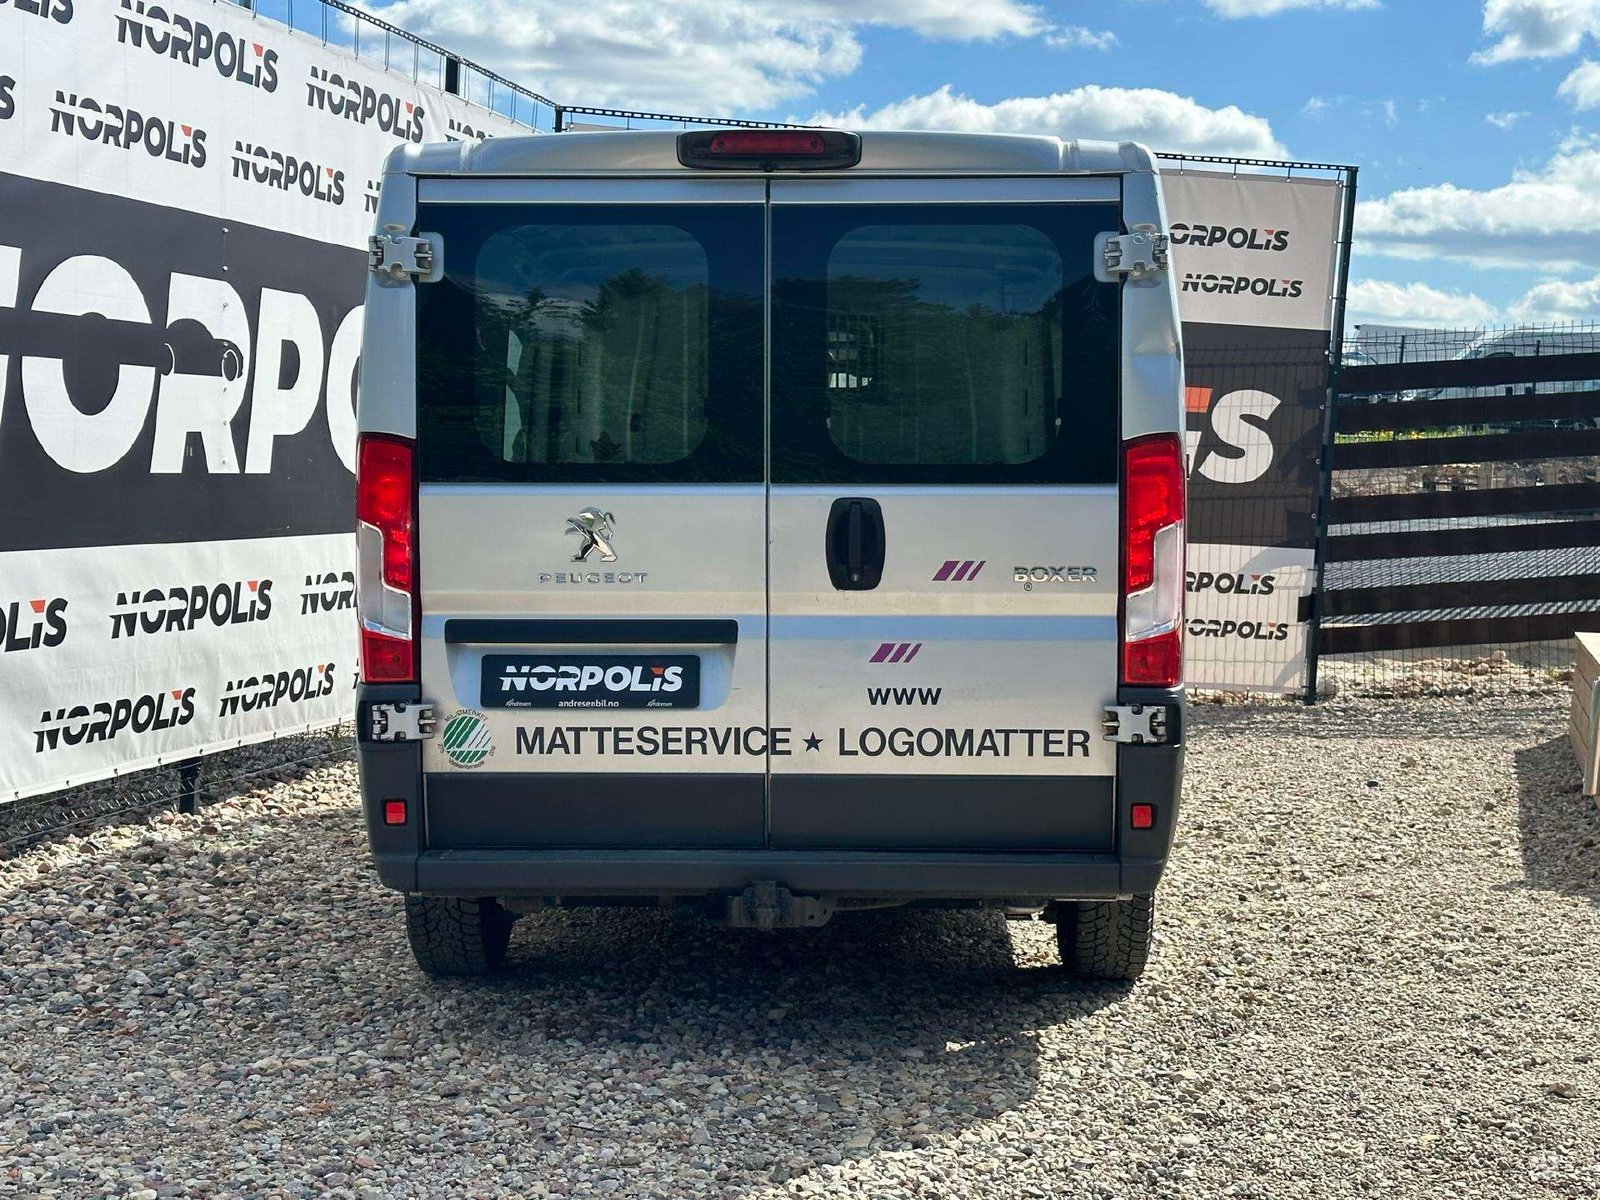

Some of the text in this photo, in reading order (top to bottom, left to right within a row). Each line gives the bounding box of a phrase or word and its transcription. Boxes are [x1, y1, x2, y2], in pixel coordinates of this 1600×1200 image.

[538, 572, 648, 584] PEUGEOT
[1013, 566, 1098, 582] BOXER
[558, 699, 620, 708] andresenbil.no
[516, 726, 1090, 757] MATTESERVICE LOGOMATTER
